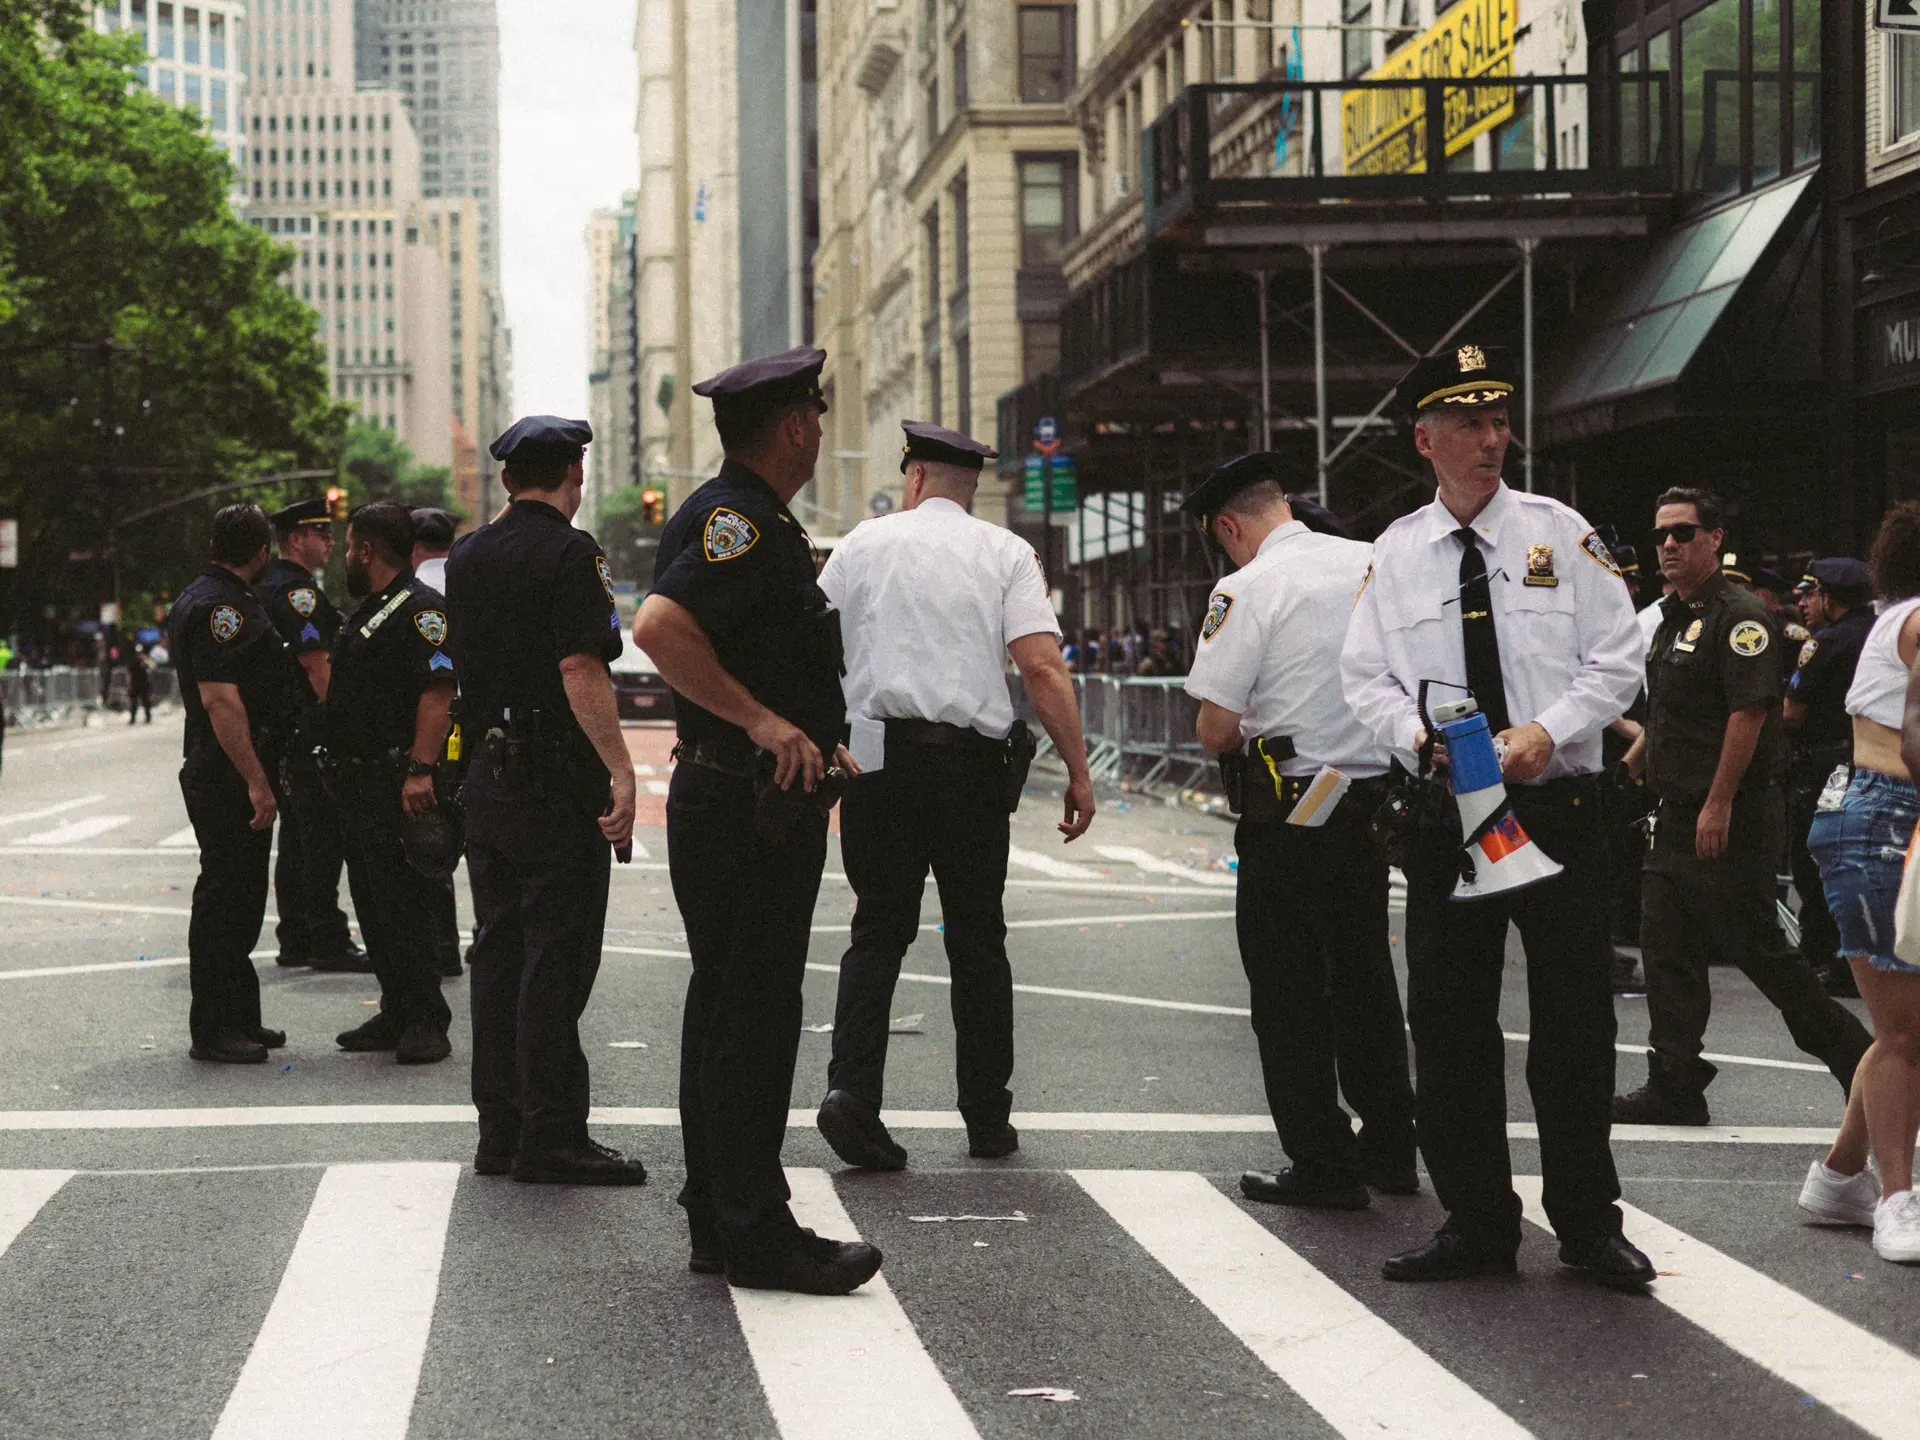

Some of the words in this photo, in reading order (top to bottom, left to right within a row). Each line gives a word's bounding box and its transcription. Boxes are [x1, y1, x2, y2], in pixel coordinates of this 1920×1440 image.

[1460, 0, 1509, 75] SALE
[1884, 320, 1920, 366] MU
[715, 515, 752, 541] DEPARTMENT
[727, 513, 749, 531] POLICE
